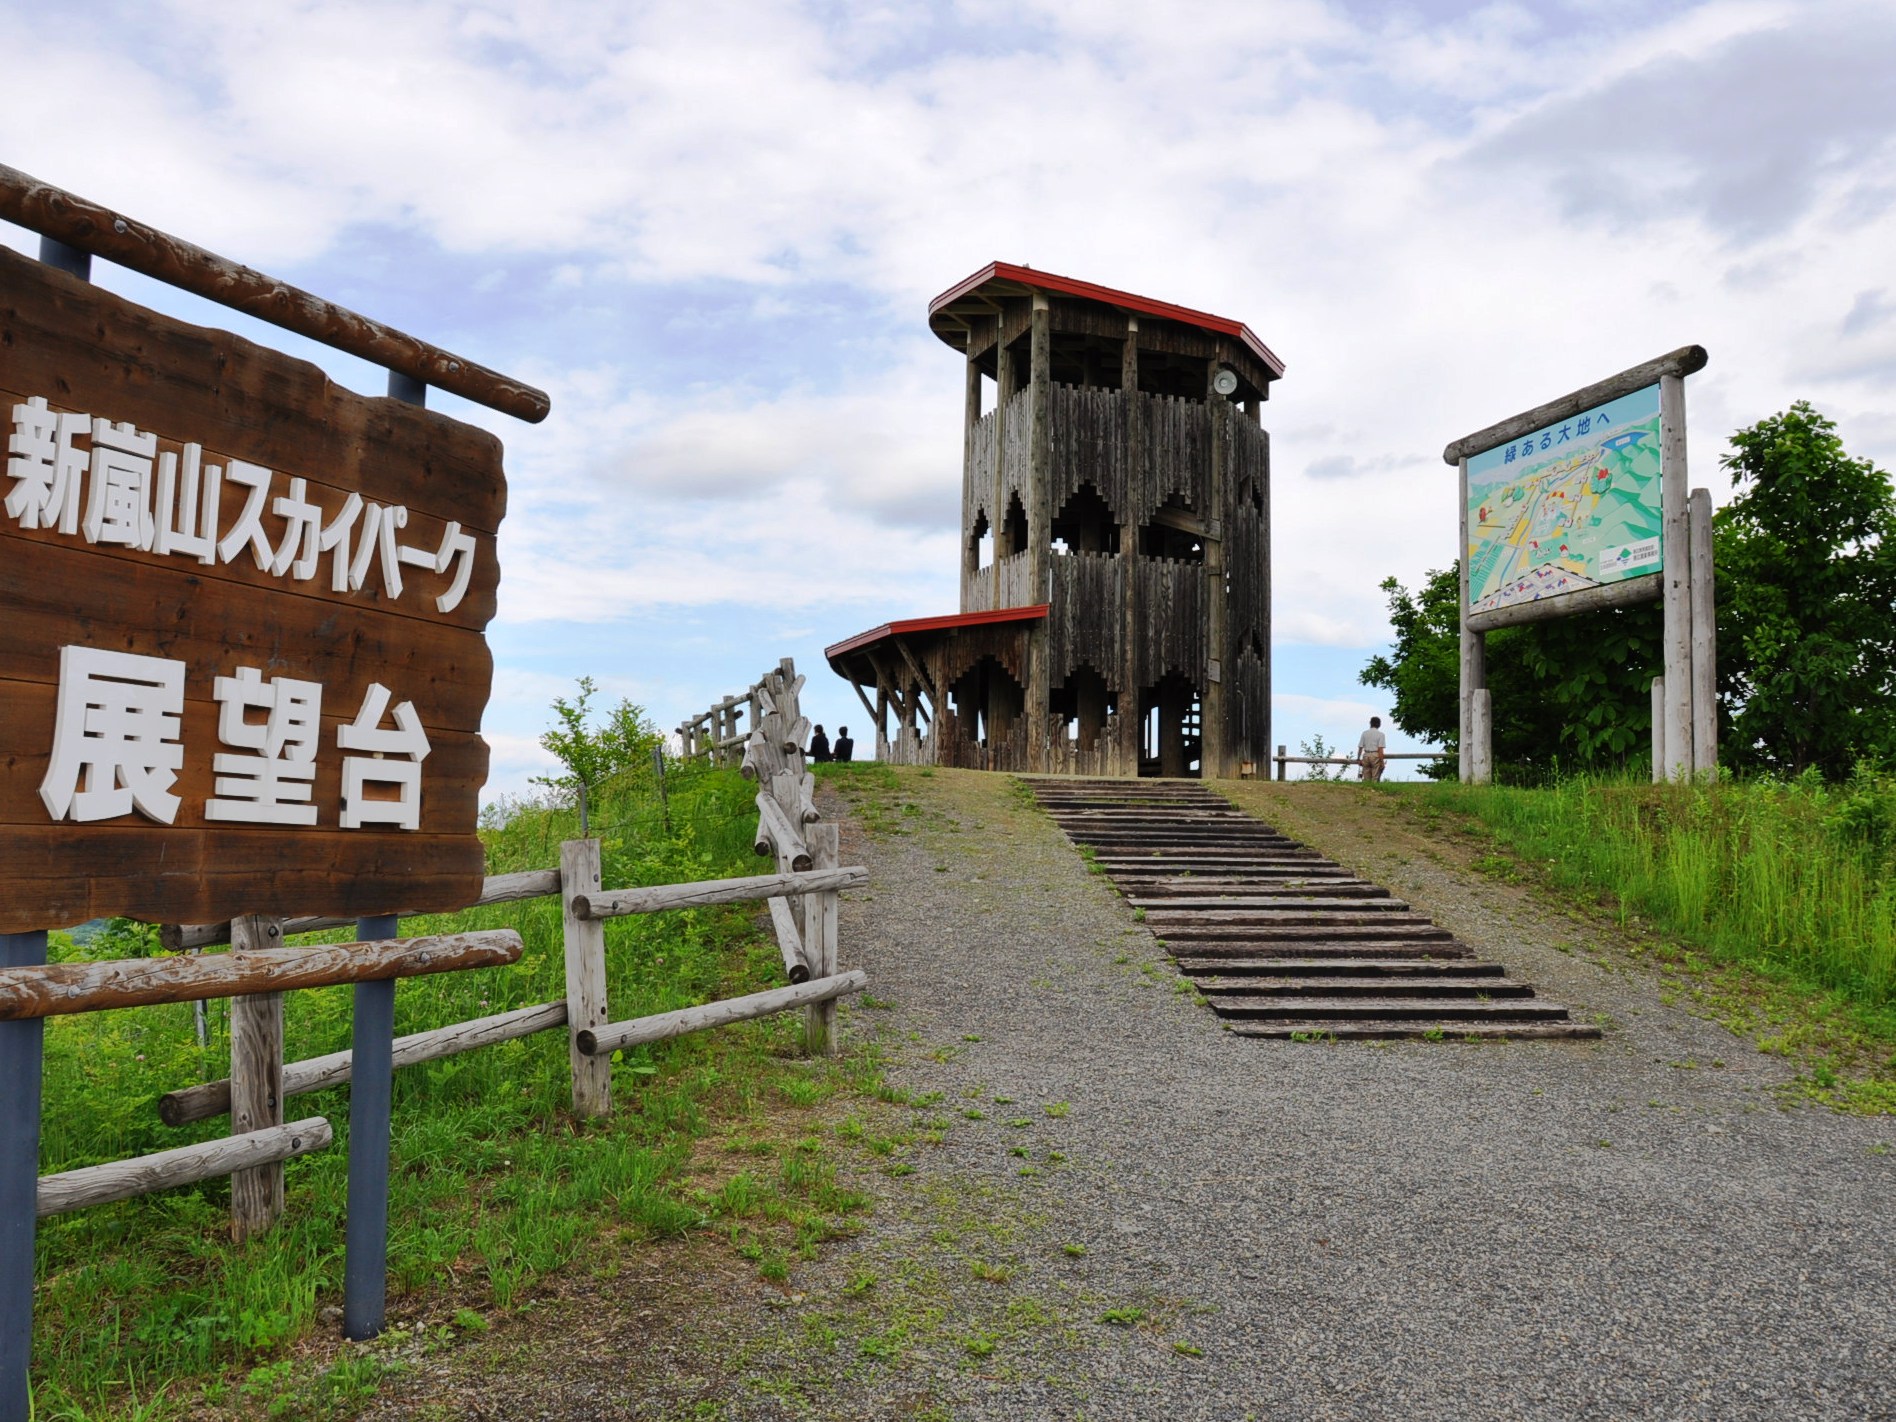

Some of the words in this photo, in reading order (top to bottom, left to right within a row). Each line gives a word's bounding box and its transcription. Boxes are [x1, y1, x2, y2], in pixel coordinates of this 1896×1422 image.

[5, 396, 477, 613] 新嵐山スカイパーク
[1504, 412, 1610, 464] 緑ある大地へ
[37, 644, 432, 831] 展望台
